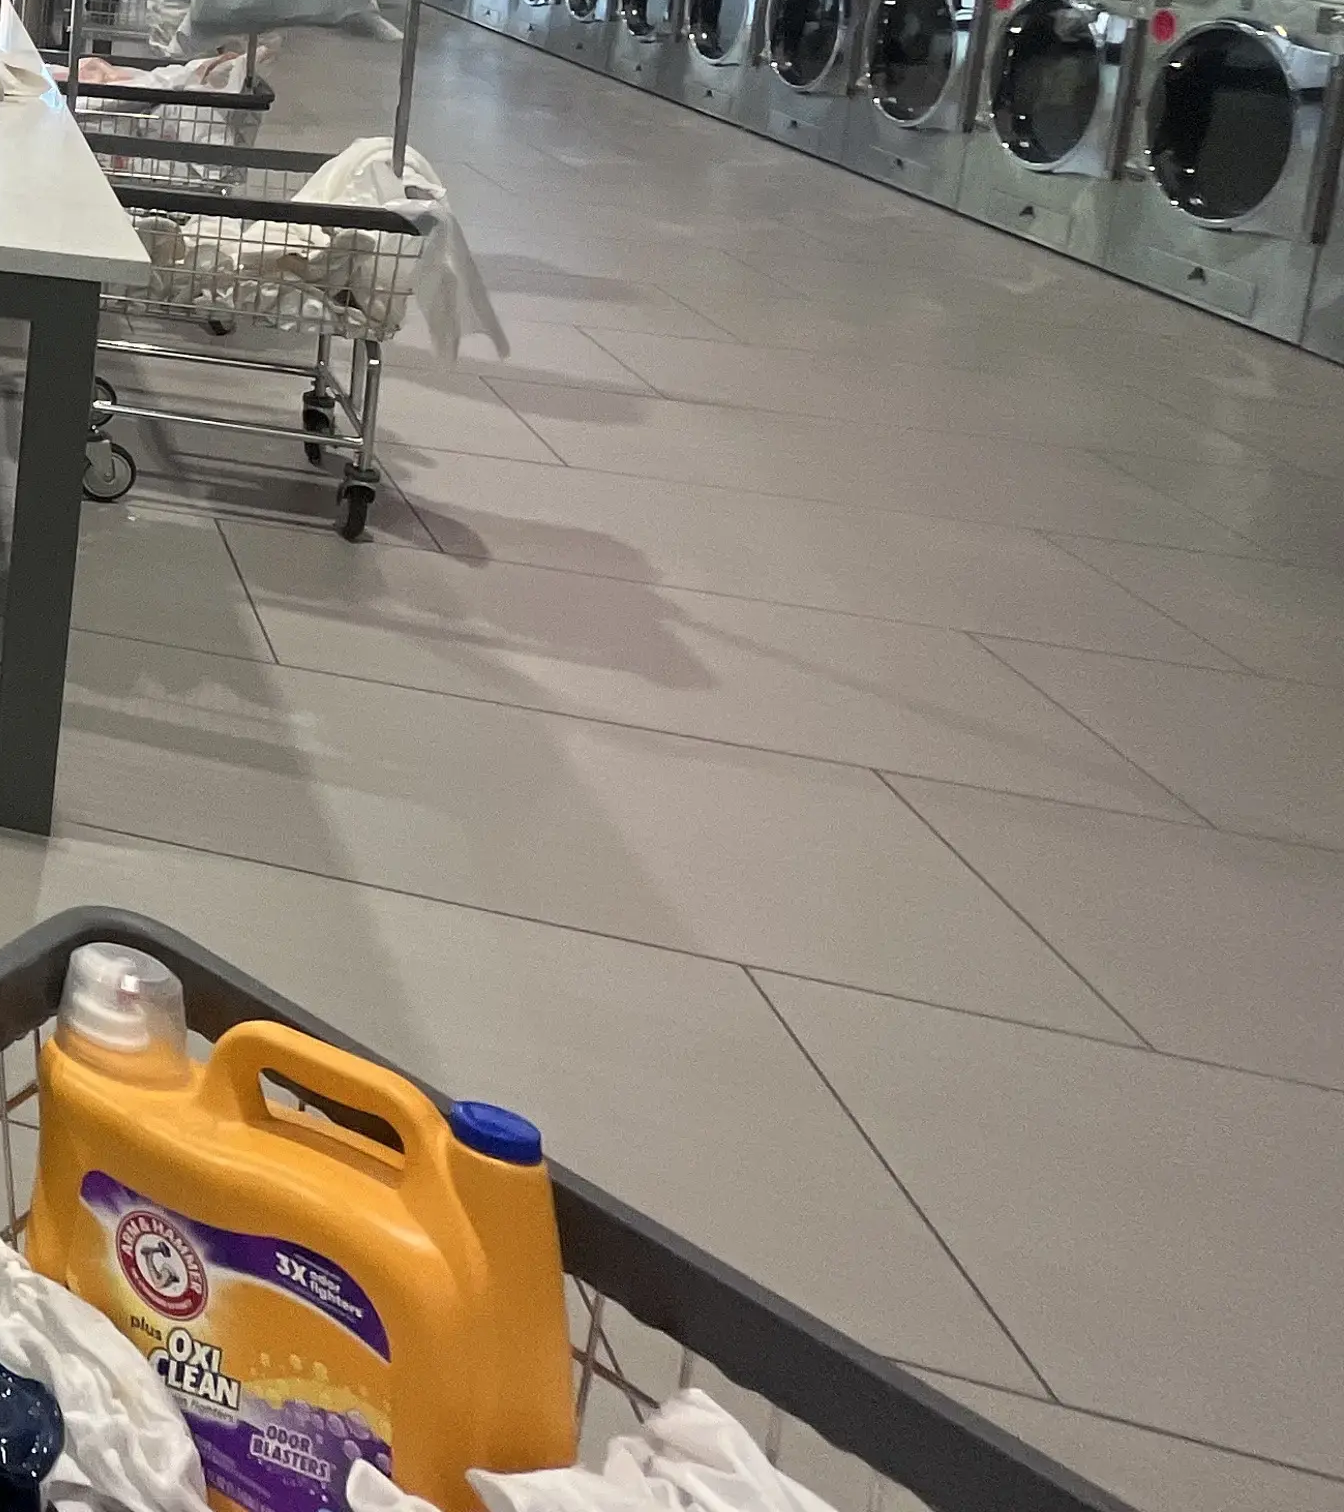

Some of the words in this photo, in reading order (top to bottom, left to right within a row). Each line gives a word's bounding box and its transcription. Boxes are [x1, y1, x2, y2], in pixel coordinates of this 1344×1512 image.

[120, 1218, 142, 1258] ARM
[152, 1218, 203, 1295] HAMMER
[274, 1251, 309, 1288] 3X
[130, 1314, 162, 1341] plus
[167, 1326, 223, 1374] OXI
[252, 1437, 329, 1479] BLASTERS
[265, 1424, 312, 1455] ODOR
